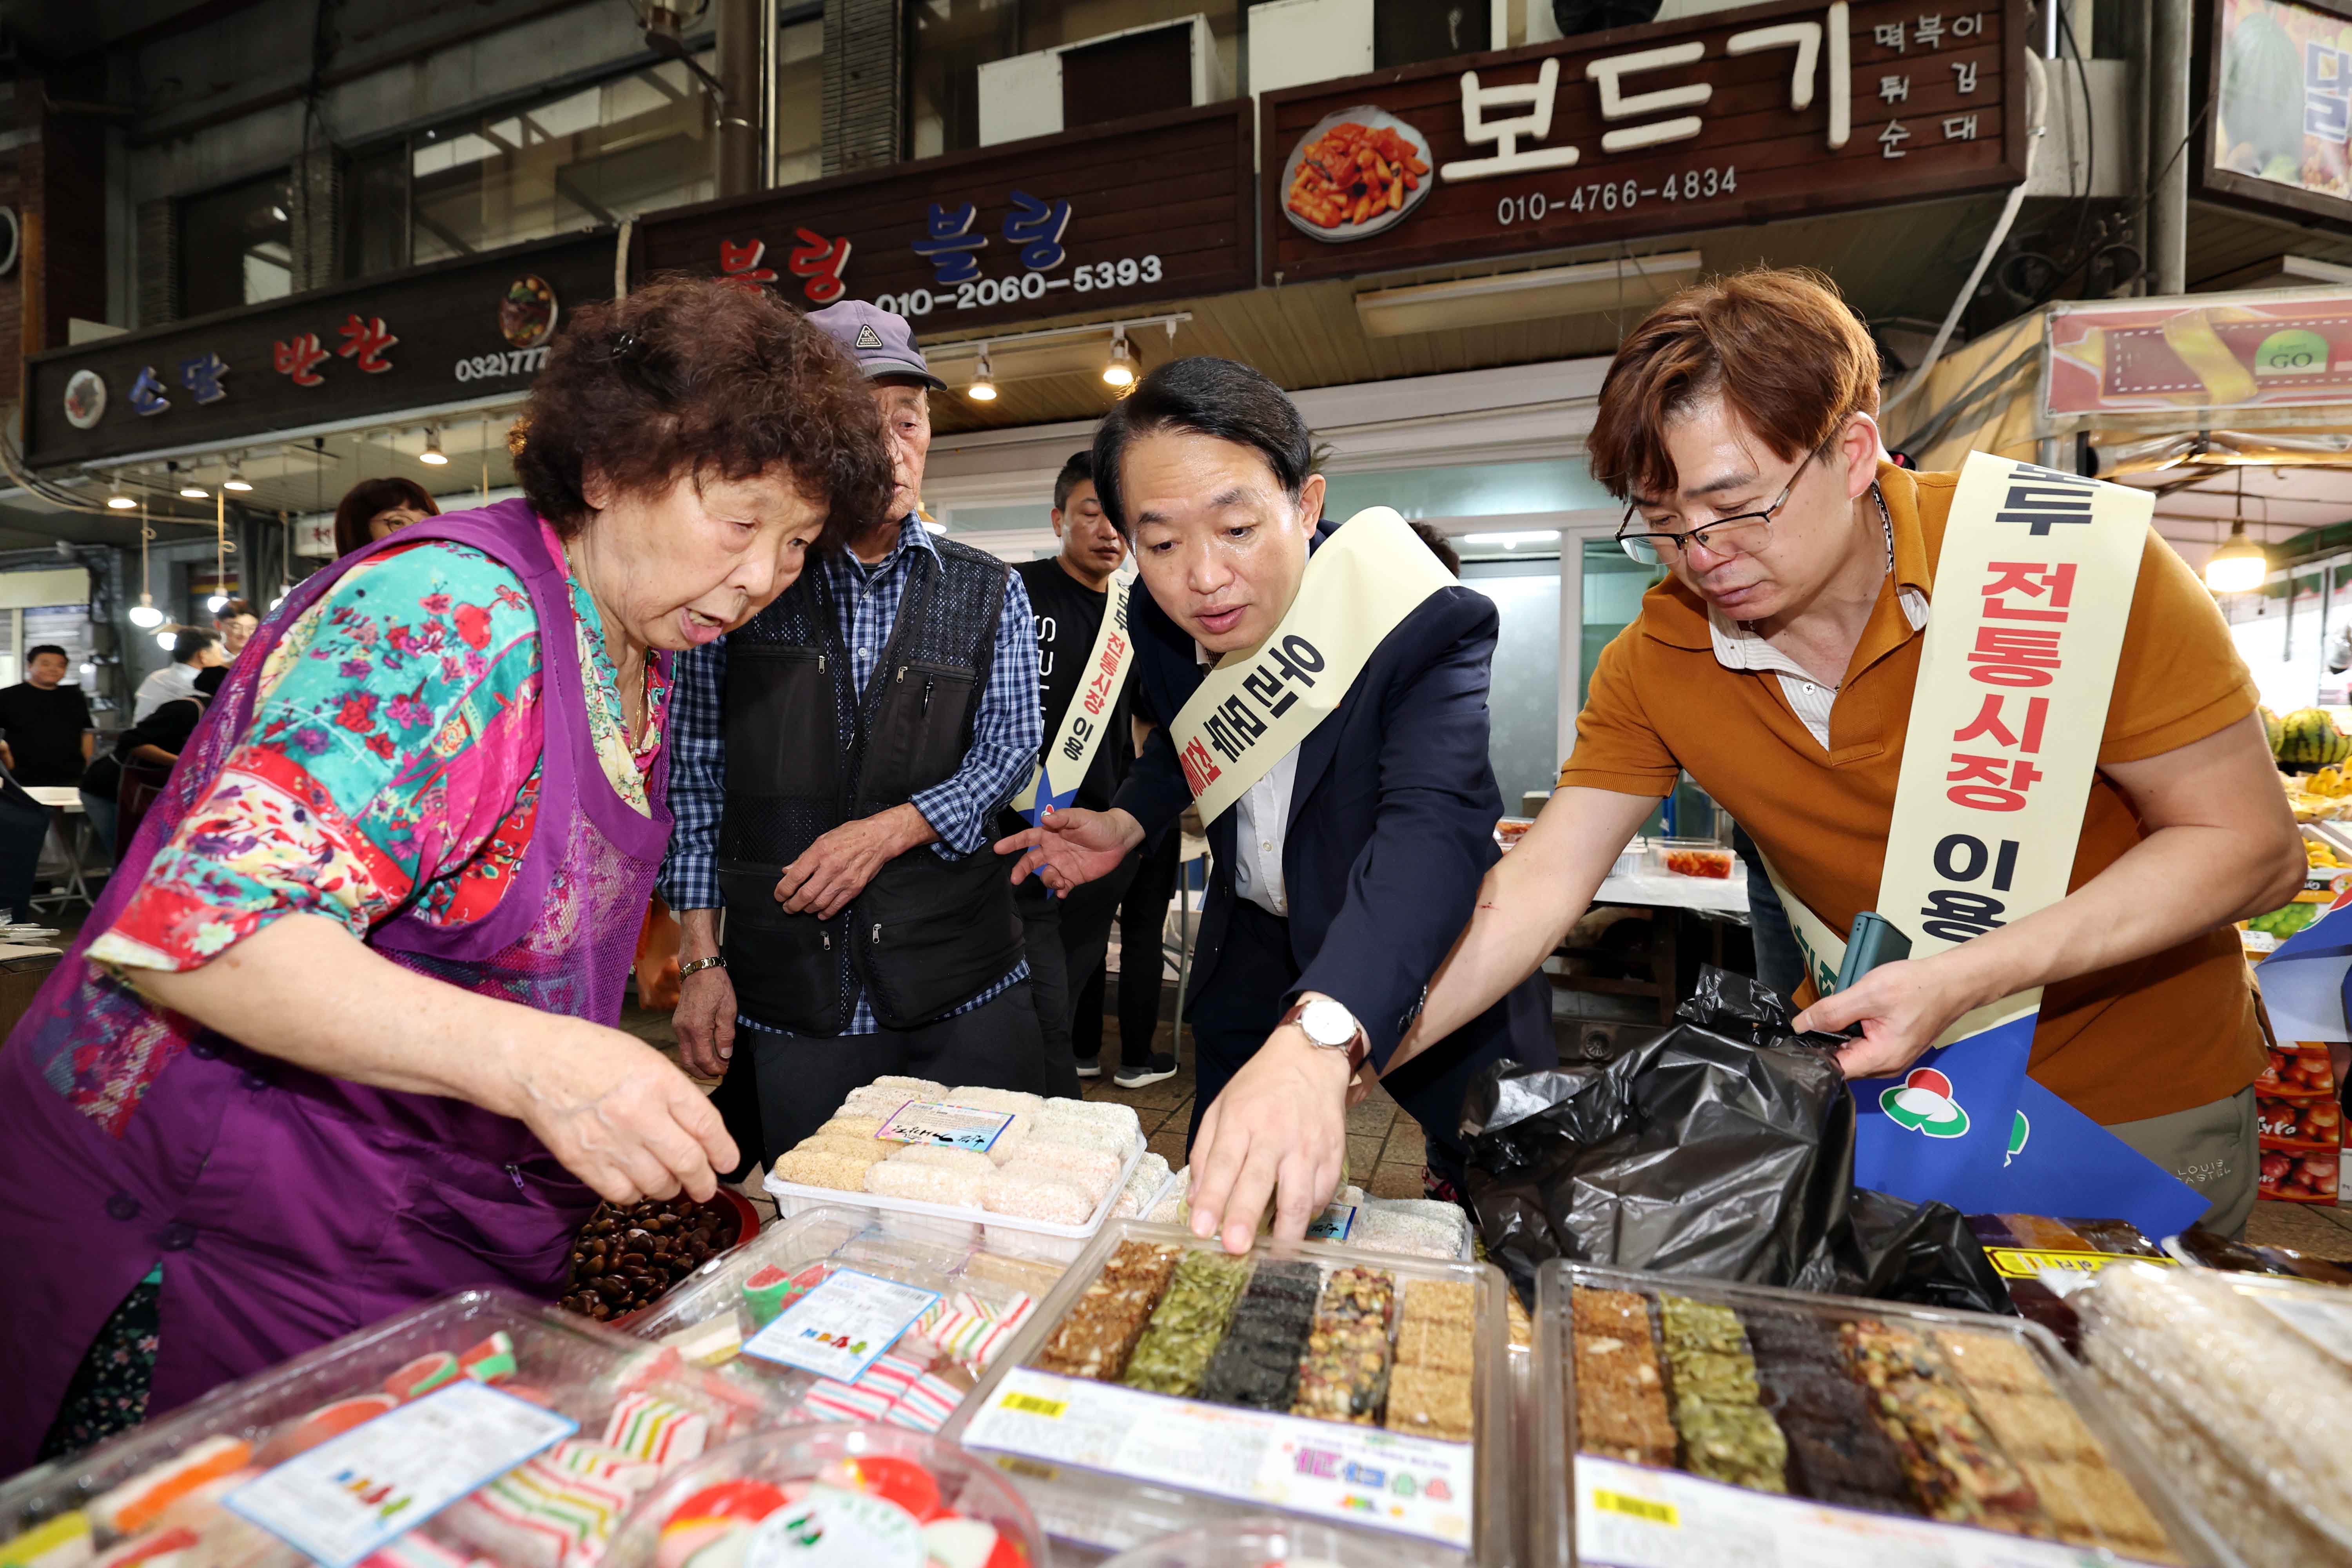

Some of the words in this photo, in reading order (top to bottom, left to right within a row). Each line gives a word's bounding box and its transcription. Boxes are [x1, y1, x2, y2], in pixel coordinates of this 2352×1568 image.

[1440, 2, 1851, 183] 보드기
[1878, 114, 1978, 158] 순대
[1497, 165, 1737, 225] 010-4766-4834
[911, 189, 1072, 285] 블링
[875, 255, 1163, 317] 010-2060-5393
[274, 314, 399, 387] 반찬
[2270, 352, 2312, 369] GO
[1084, 631, 1125, 715] 전통시장
[1242, 635, 1325, 719] 우리
[1946, 562, 2077, 811] 전통시장
[1063, 717, 1094, 761] 이용
[1203, 694, 1268, 763] 모두
[1921, 834, 2020, 943] 이용
[2178, 1159, 2223, 1176] LOUIS
